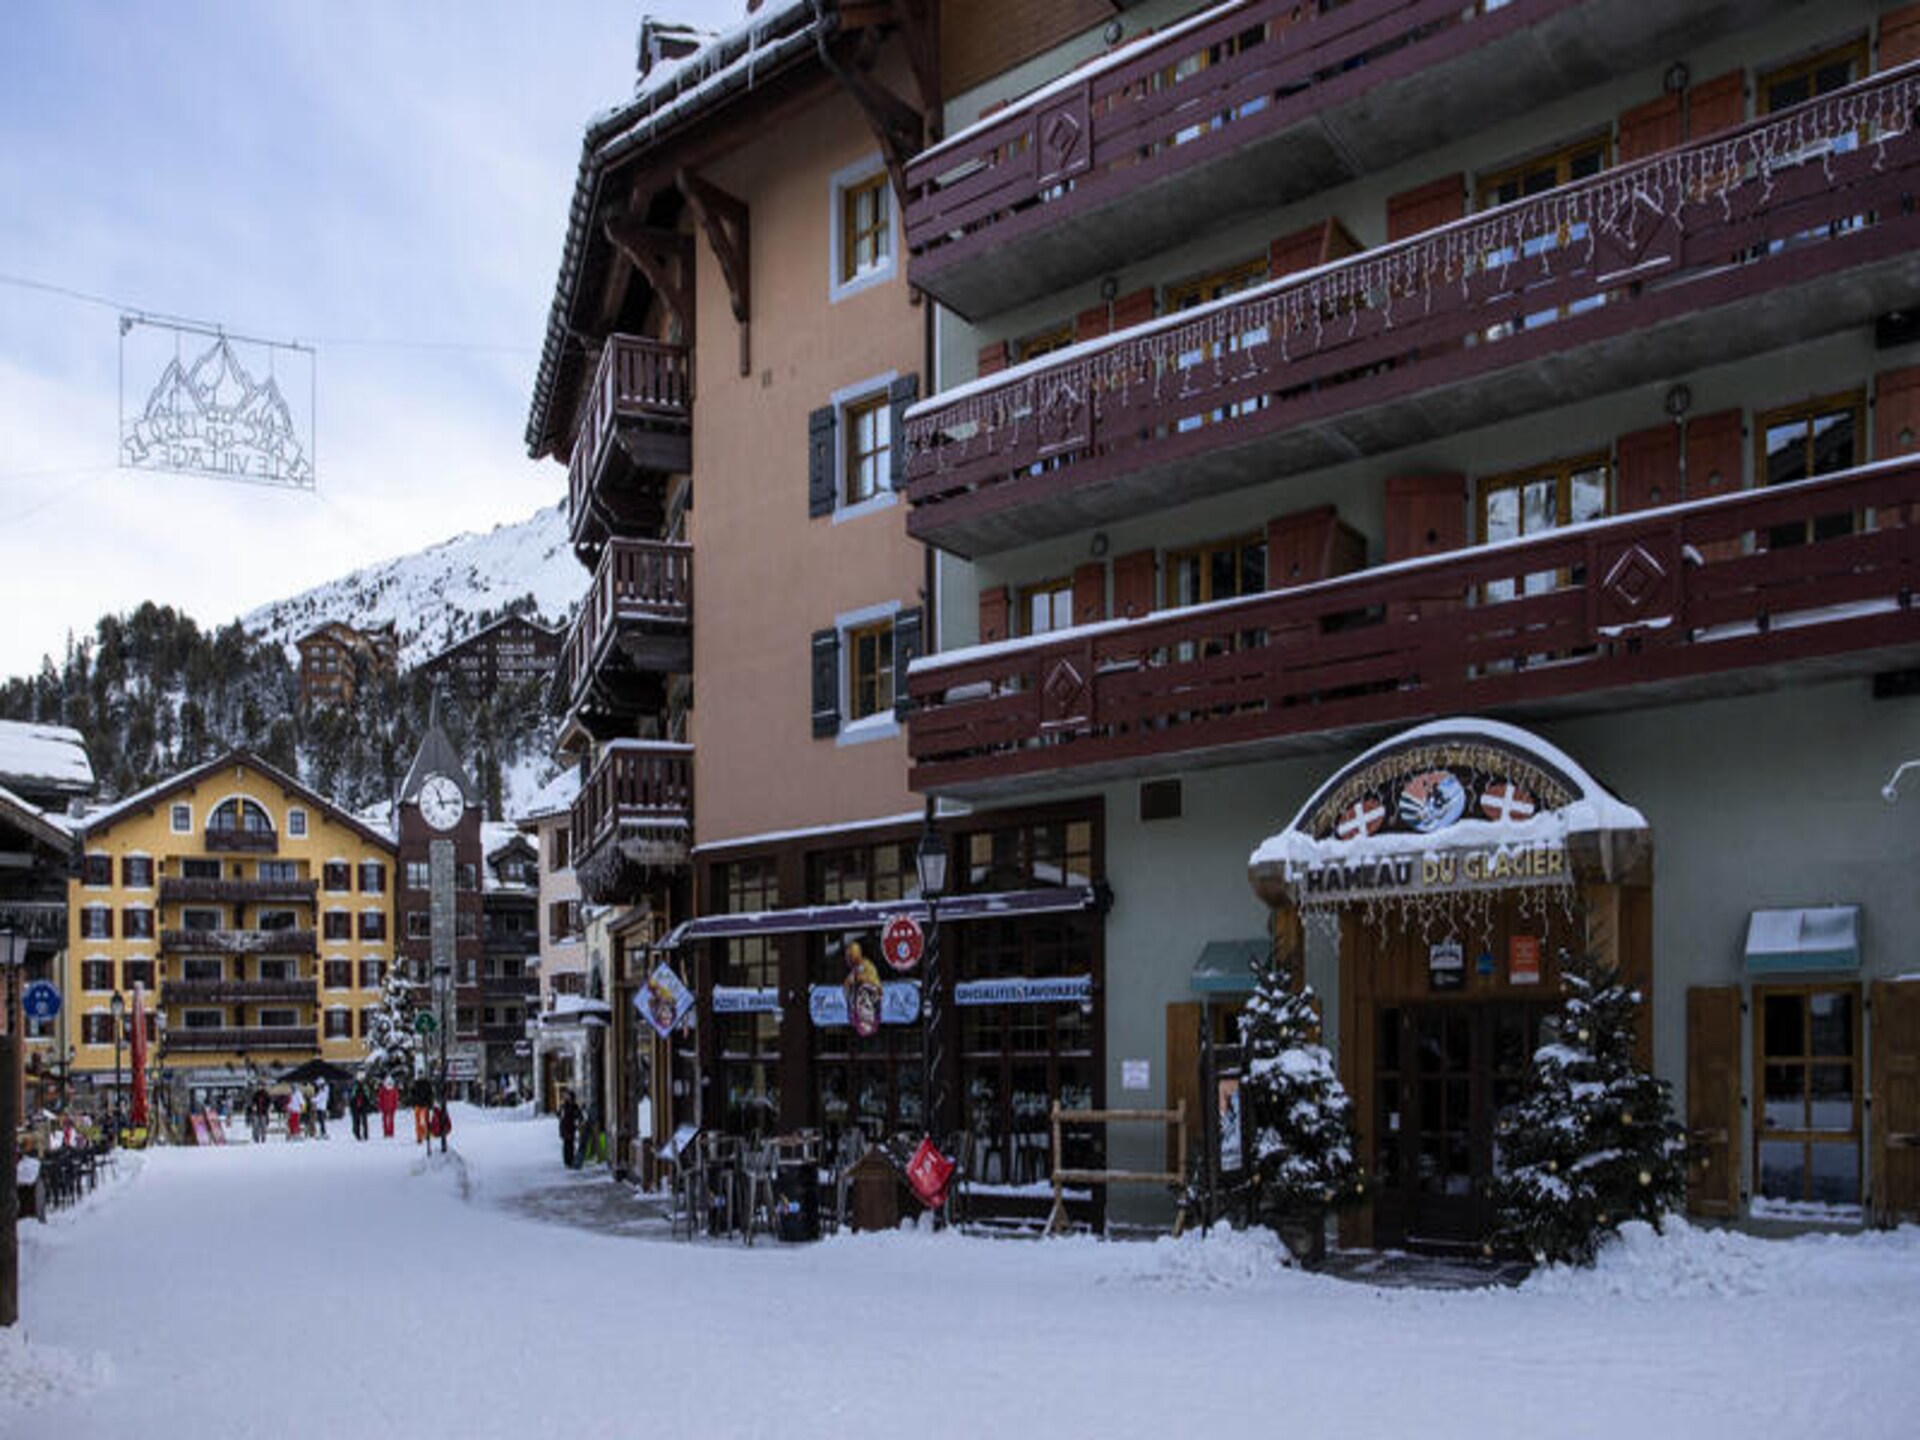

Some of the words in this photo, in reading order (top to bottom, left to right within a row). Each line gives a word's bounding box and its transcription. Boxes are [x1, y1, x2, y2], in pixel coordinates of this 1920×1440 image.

[1306, 854, 1413, 892] HAMEAU
[1422, 848, 1458, 885] DU
[1462, 842, 1564, 881] GLACIER
